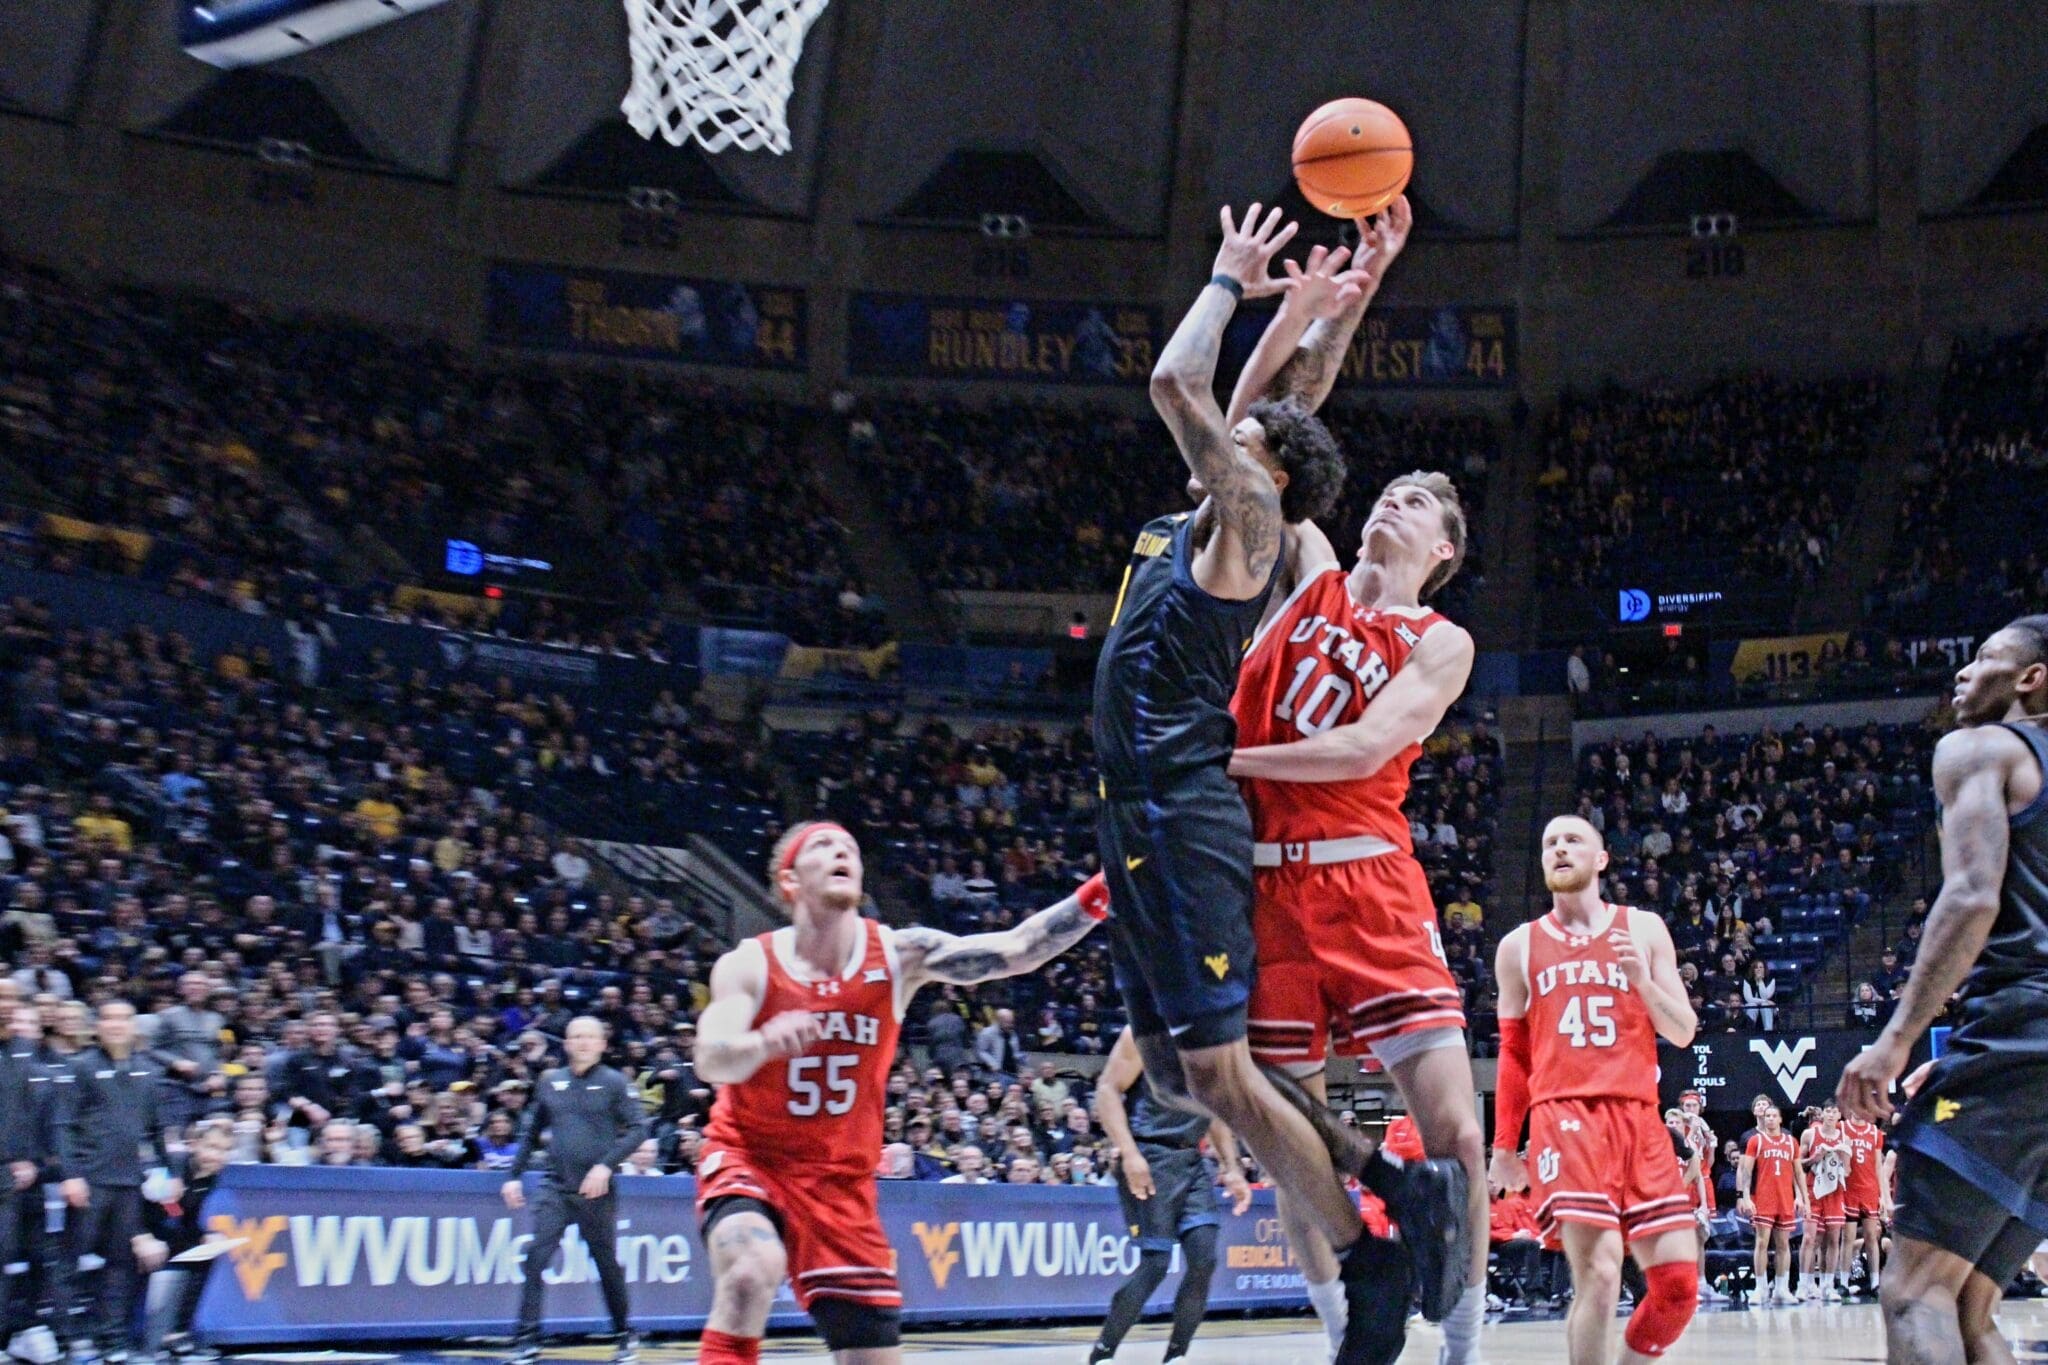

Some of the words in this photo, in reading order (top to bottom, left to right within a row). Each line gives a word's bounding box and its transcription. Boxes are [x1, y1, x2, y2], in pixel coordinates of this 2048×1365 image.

[929, 328, 1076, 376] HUNDLEY
[1467, 339, 1506, 378] 44
[1289, 615, 1390, 700] UTAH
[1766, 651, 1809, 680] 113
[1275, 655, 1352, 737] 10
[1536, 960, 1629, 998] UTAH
[816, 1011, 880, 1046] AH
[1558, 996, 1617, 1048] 45
[1692, 1045, 1713, 1054] TOL
[1698, 1055, 1708, 1075] 2
[787, 1055, 859, 1117] 55
[1693, 1078, 1726, 1087] FOULS
[1774, 1159, 1782, 1176] 1
[1856, 1148, 1865, 1164] 5
